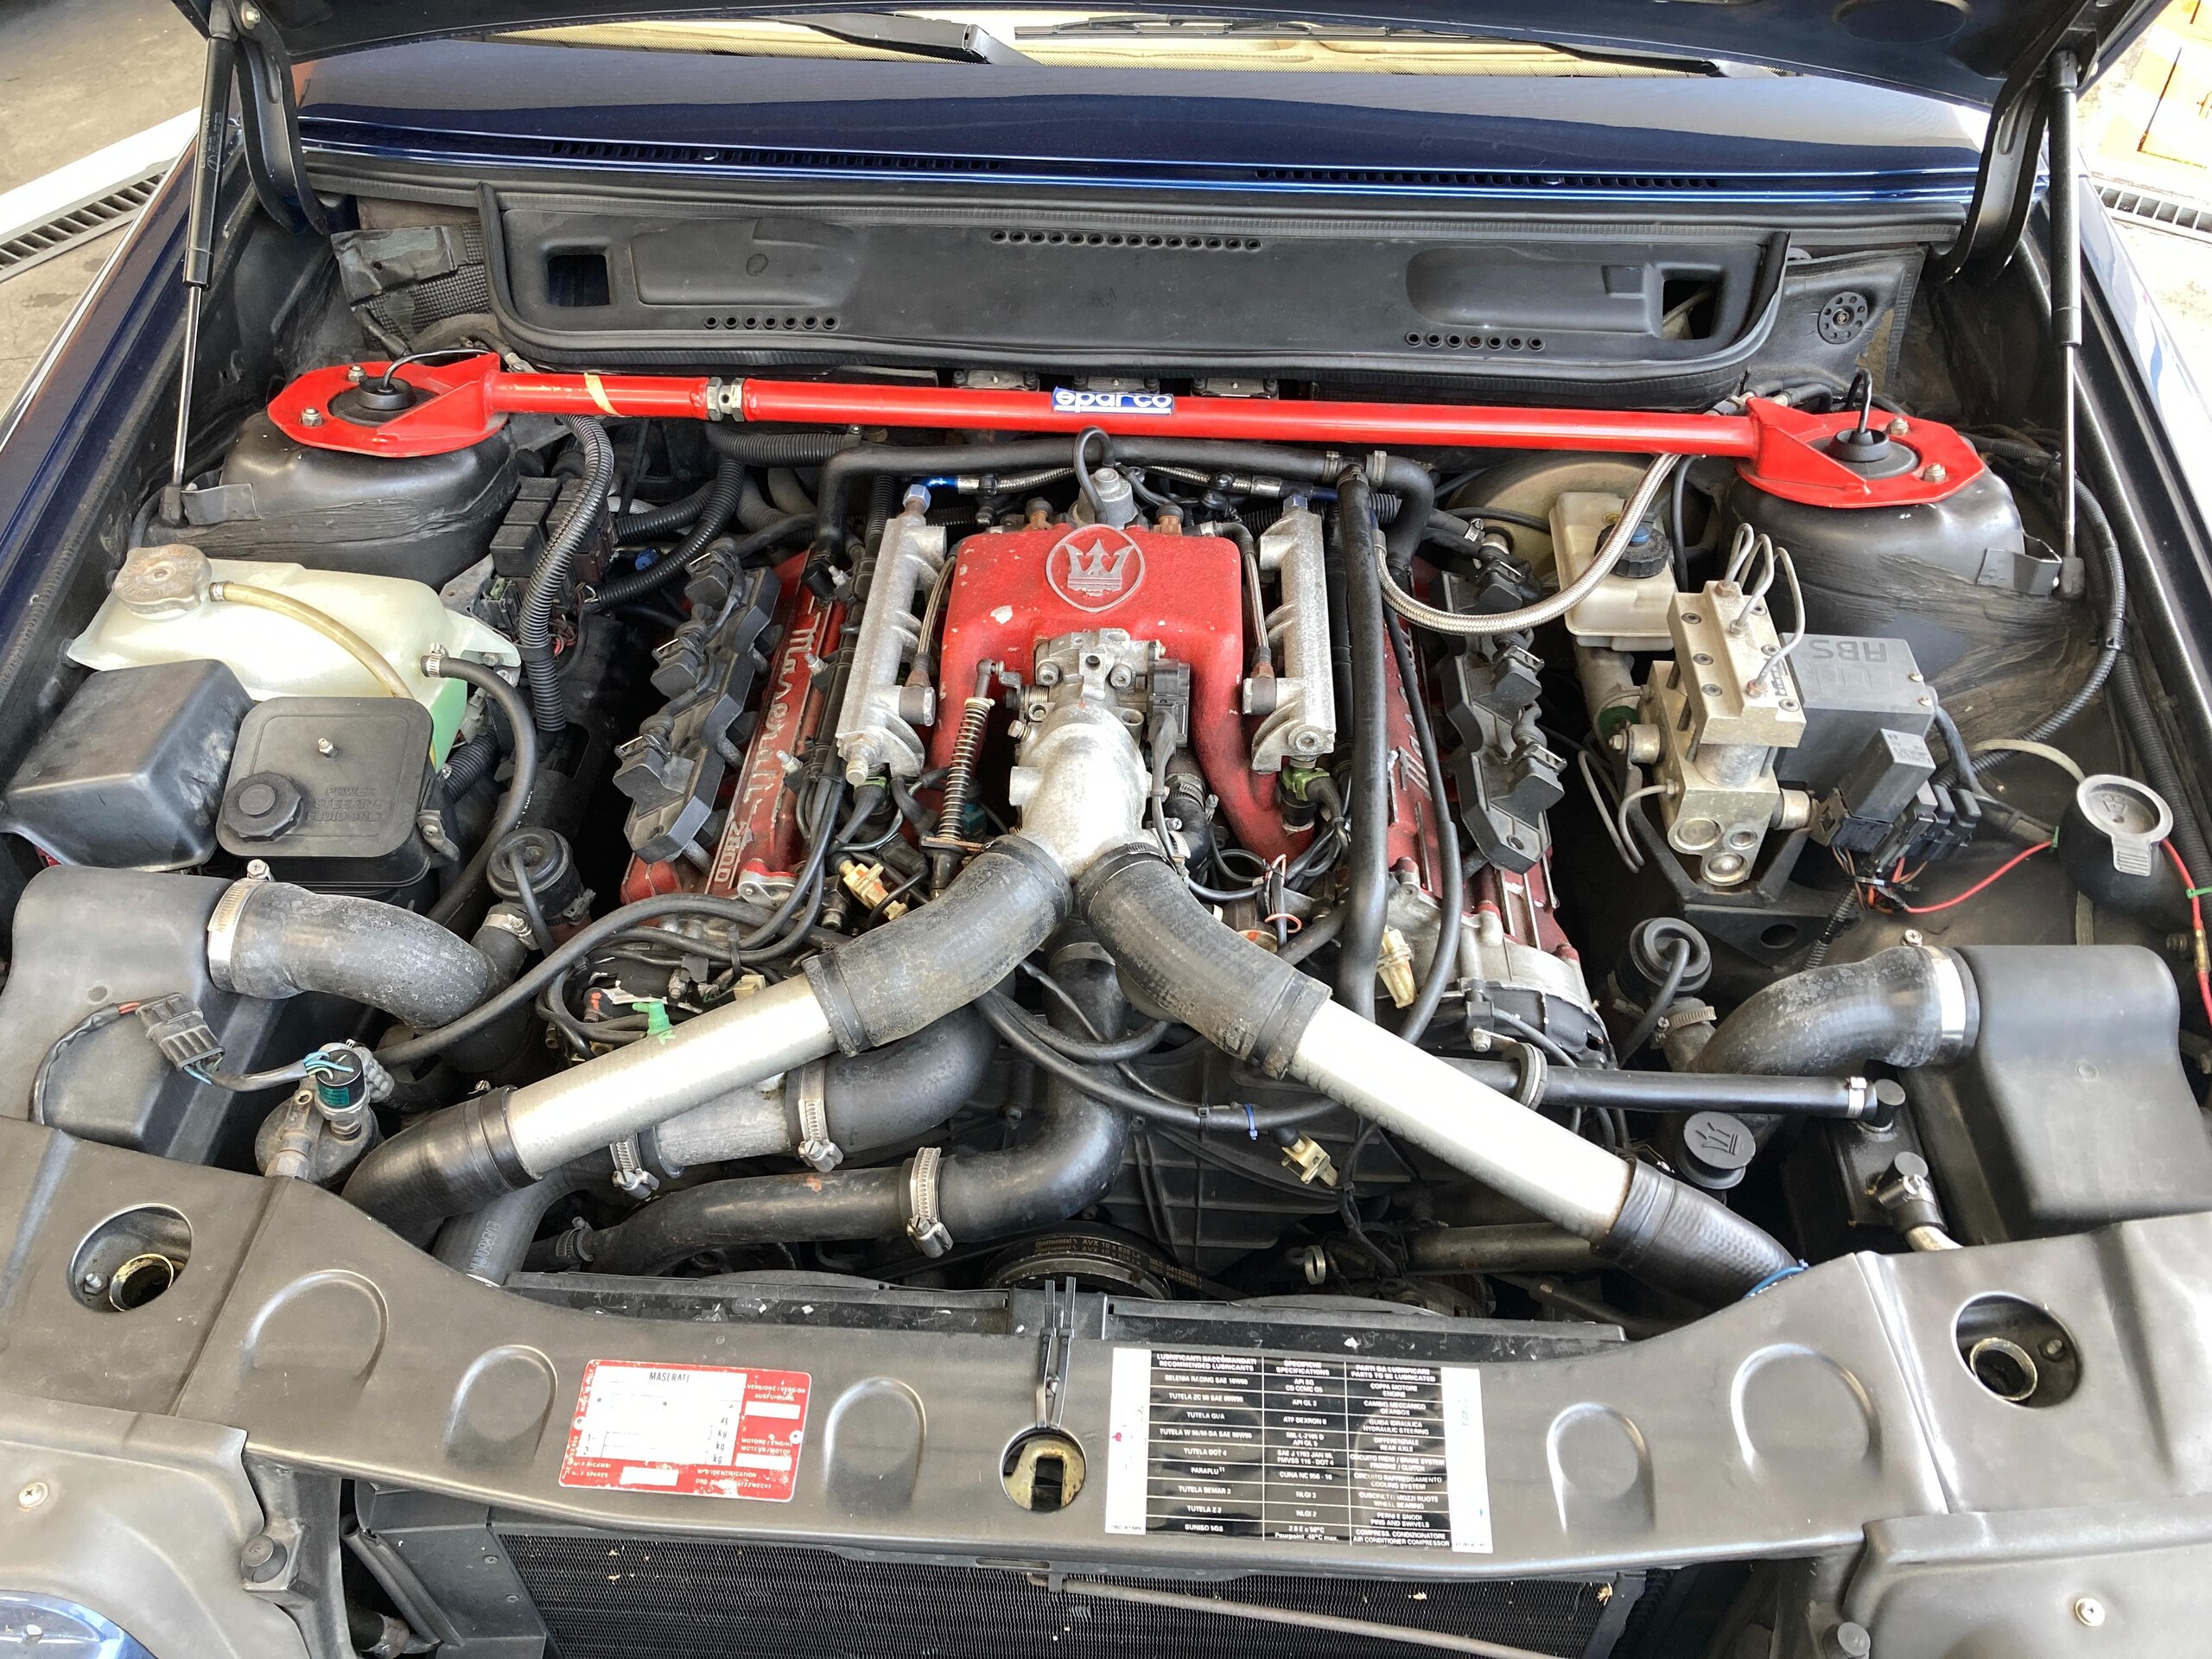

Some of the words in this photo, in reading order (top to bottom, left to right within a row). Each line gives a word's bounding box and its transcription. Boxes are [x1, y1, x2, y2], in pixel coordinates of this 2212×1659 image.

[1055, 391, 1172, 410] sparco
[1808, 639, 1888, 663] ABS
[327, 786, 377, 797] POWER
[314, 798, 384, 810] STEERING
[714, 820, 751, 883] 2800
[1156, 1352, 1201, 1362] LUBRIFICANTI
[1202, 1355, 1256, 1365] RACCOMANDATI
[1159, 1359, 1211, 1369] RECOMMENDED
[1211, 1363, 1254, 1371] LUBRICANTS
[1275, 1366, 1330, 1376] SPECIFICATIONS
[649, 1371, 690, 1383] MASERATI
[1190, 1375, 1214, 1383] RACING
[1394, 1373, 1436, 1382] LUBRICATED
[1370, 1382, 1391, 1390] COPPA
[1390, 1383, 1417, 1392] MOTORE
[1363, 1399, 1389, 1408] CAMBIO
[1389, 1401, 1427, 1410] MECCANICO
[1294, 1416, 1321, 1425] DEXRON
[1159, 1427, 1183, 1436] TUTELA
[1362, 1425, 1398, 1433] HYDRAULIC
[1398, 1427, 1429, 1435] STEERING
[1373, 1436, 1419, 1446] DIFFERENZIALE
[741, 1445, 766, 1453] MOTEUR
[1183, 1447, 1208, 1456] TUTELA
[713, 1453, 723, 1464] kg
[1349, 1453, 1377, 1462] CIRCUITO
[1420, 1458, 1445, 1466] SYSTEM
[1353, 1471, 1382, 1480] CIRCUITO
[1382, 1473, 1442, 1483] RAFFREDDAMENTO
[1370, 1480, 1398, 1489] COOLING
[1399, 1481, 1426, 1490] SYSTEM
[1416, 1494, 1438, 1503] RUOTE
[1186, 1504, 1211, 1513] TUTELA
[1274, 1531, 1304, 1540] Pourpoint
[1355, 1529, 1391, 1537] COMPRESS.
[1391, 1530, 1446, 1540] CONDIZIONATORE
[1363, 1535, 1406, 1544] CONDITIONER
[1407, 1537, 1450, 1546] COMPRESSOR
